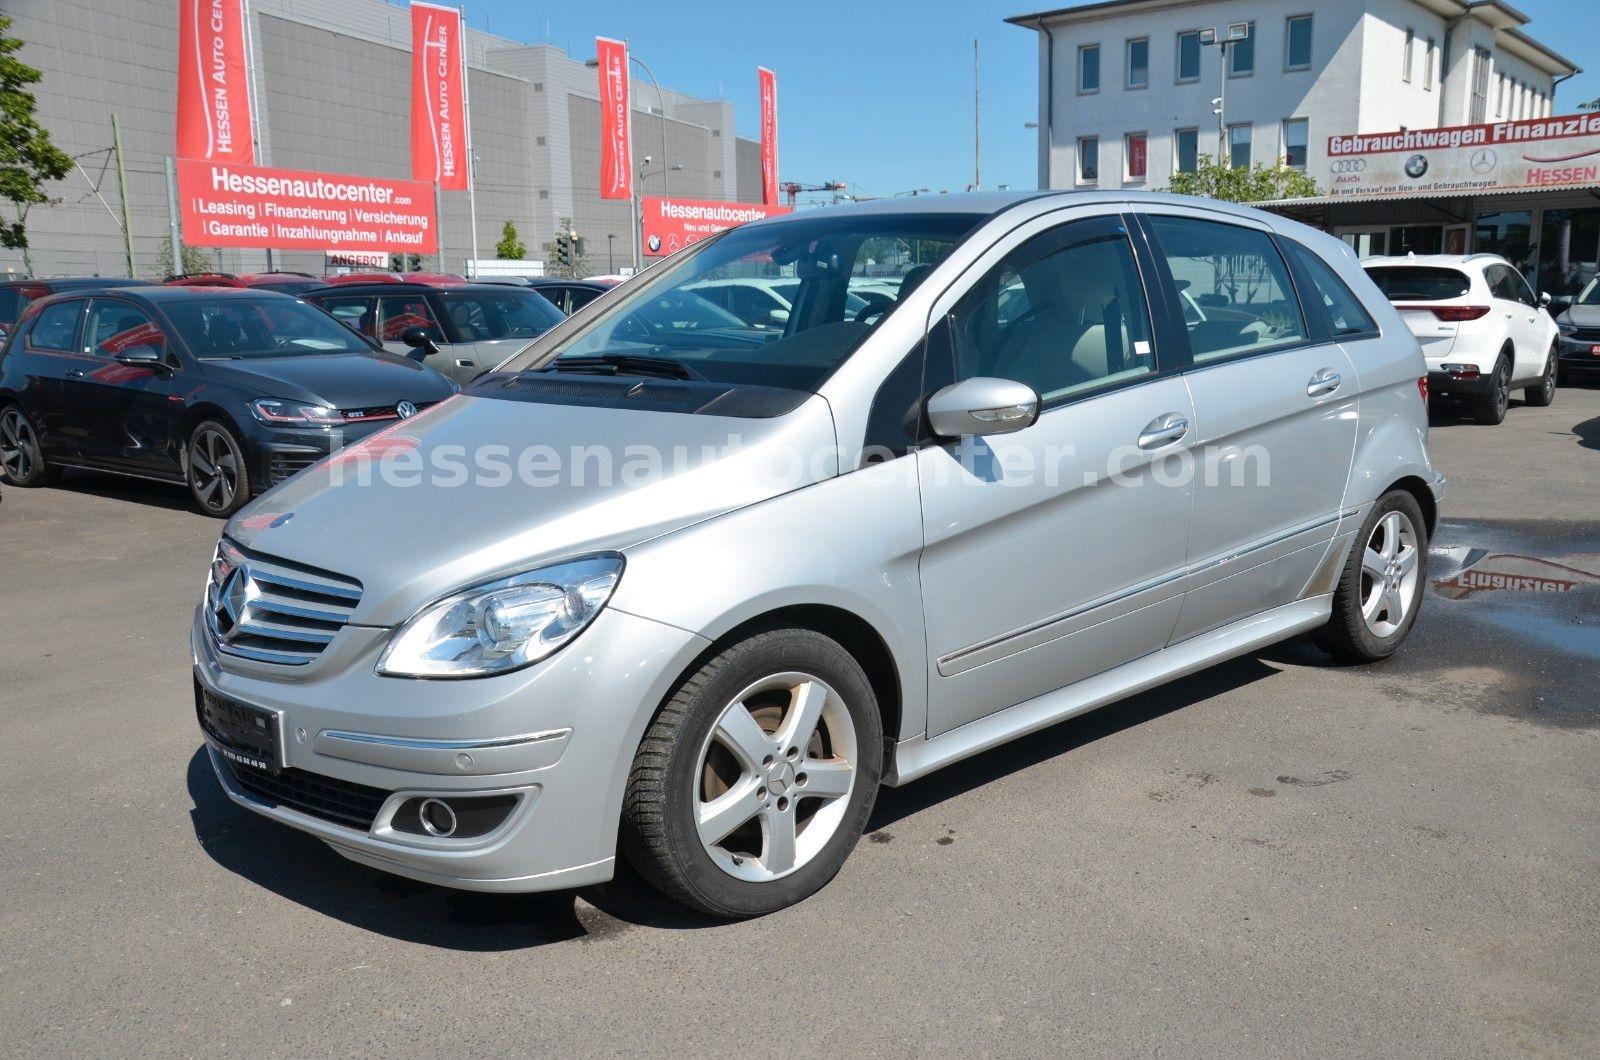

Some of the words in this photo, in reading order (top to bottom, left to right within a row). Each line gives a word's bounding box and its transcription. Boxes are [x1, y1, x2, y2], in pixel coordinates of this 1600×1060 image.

[212, 36, 226, 85] AUTO
[439, 81, 449, 119] AUTO
[214, 88, 233, 153] HESSEN
[440, 123, 455, 177] HESSEN
[1330, 128, 1486, 154] Gebrauchtwagen
[1355, 185, 1383, 194] Verkauf
[1434, 180, 1497, 191] Gebrauchtwagen
[1526, 166, 1597, 184] HESSEN
[199, 198, 256, 219] Leasing
[265, 202, 347, 225] Finanzierung
[354, 209, 428, 229] Versicherung
[660, 200, 767, 222] Hessenautocenter
[209, 220, 269, 238] Garantie
[277, 223, 377, 243] Inzahlungnahme
[385, 229, 424, 244] Ankauf
[331, 254, 384, 267] ANGEBOT
